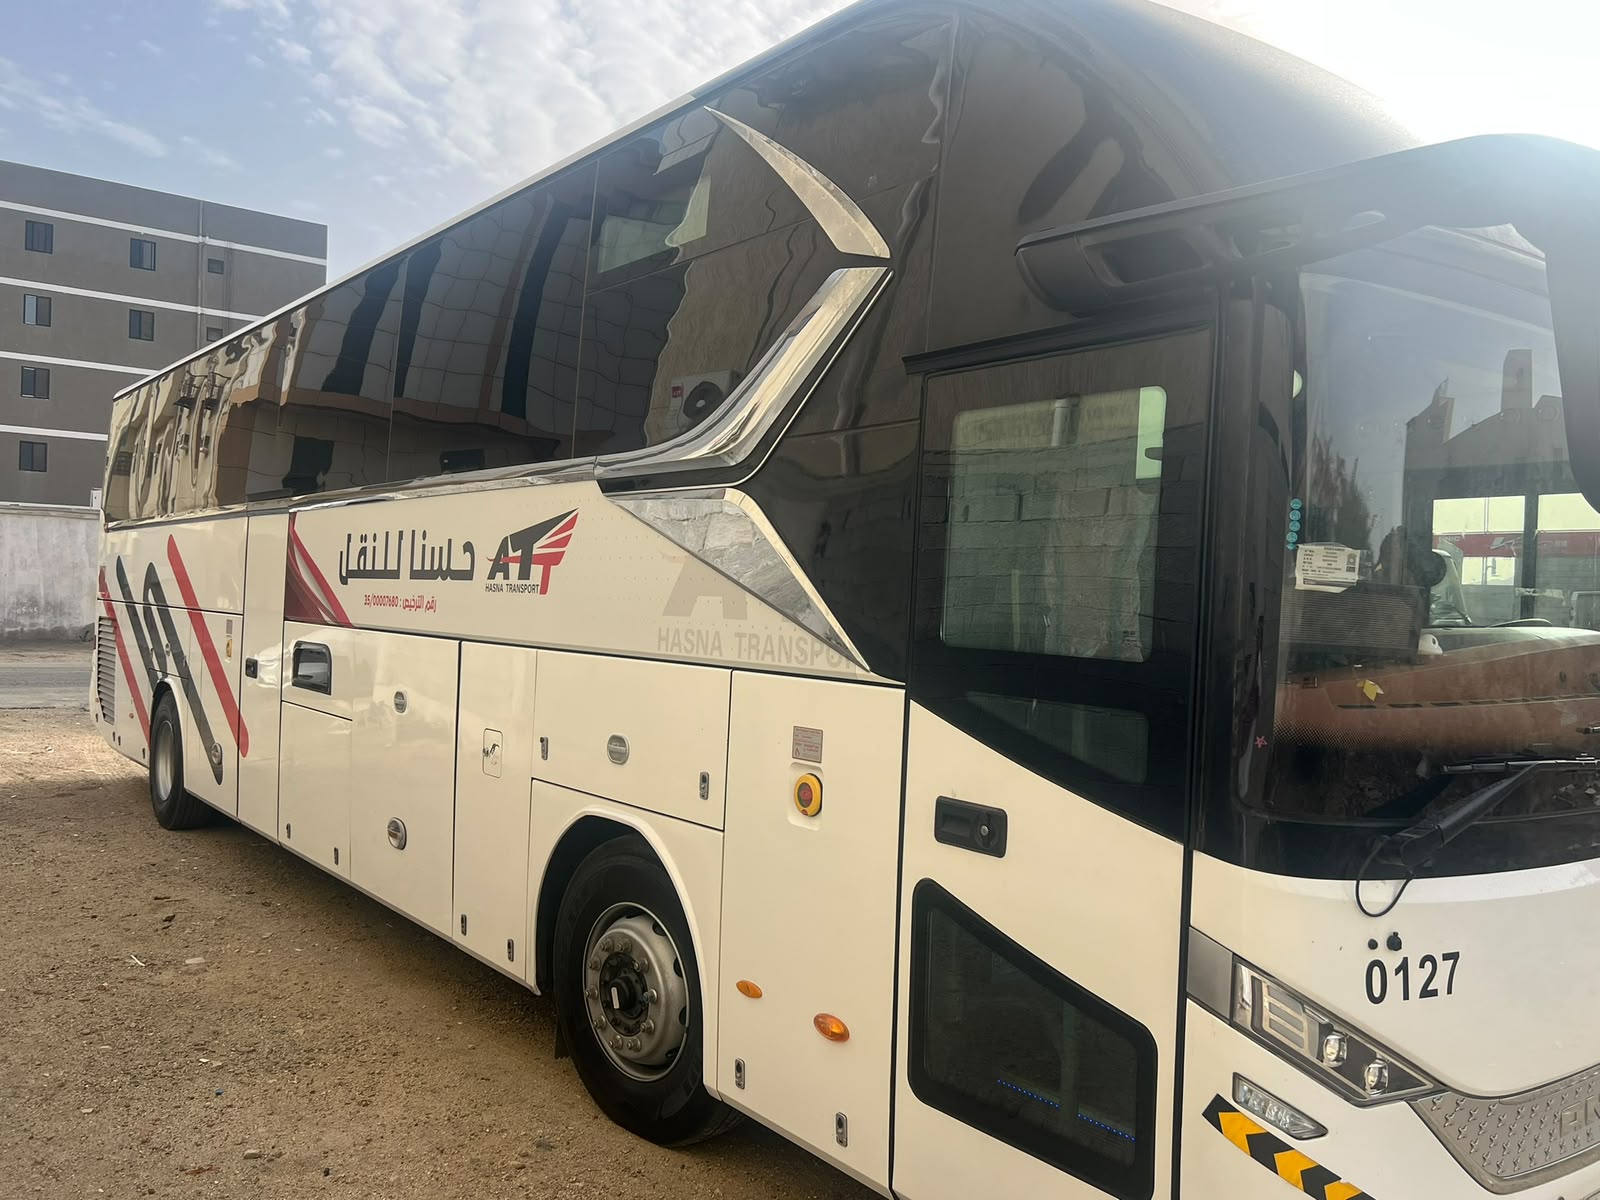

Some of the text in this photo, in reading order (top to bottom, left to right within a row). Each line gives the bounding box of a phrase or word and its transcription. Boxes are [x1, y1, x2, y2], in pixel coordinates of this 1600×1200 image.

[339, 529, 475, 585] حسنا للنقل
[402, 594, 424, 612] الترخيص
[485, 583, 540, 594] HASNA TRANSPORT
[424, 595, 437, 613] رقم
[657, 627, 851, 670] HASNA TRANSPO
[1365, 951, 1460, 1004] 0127
